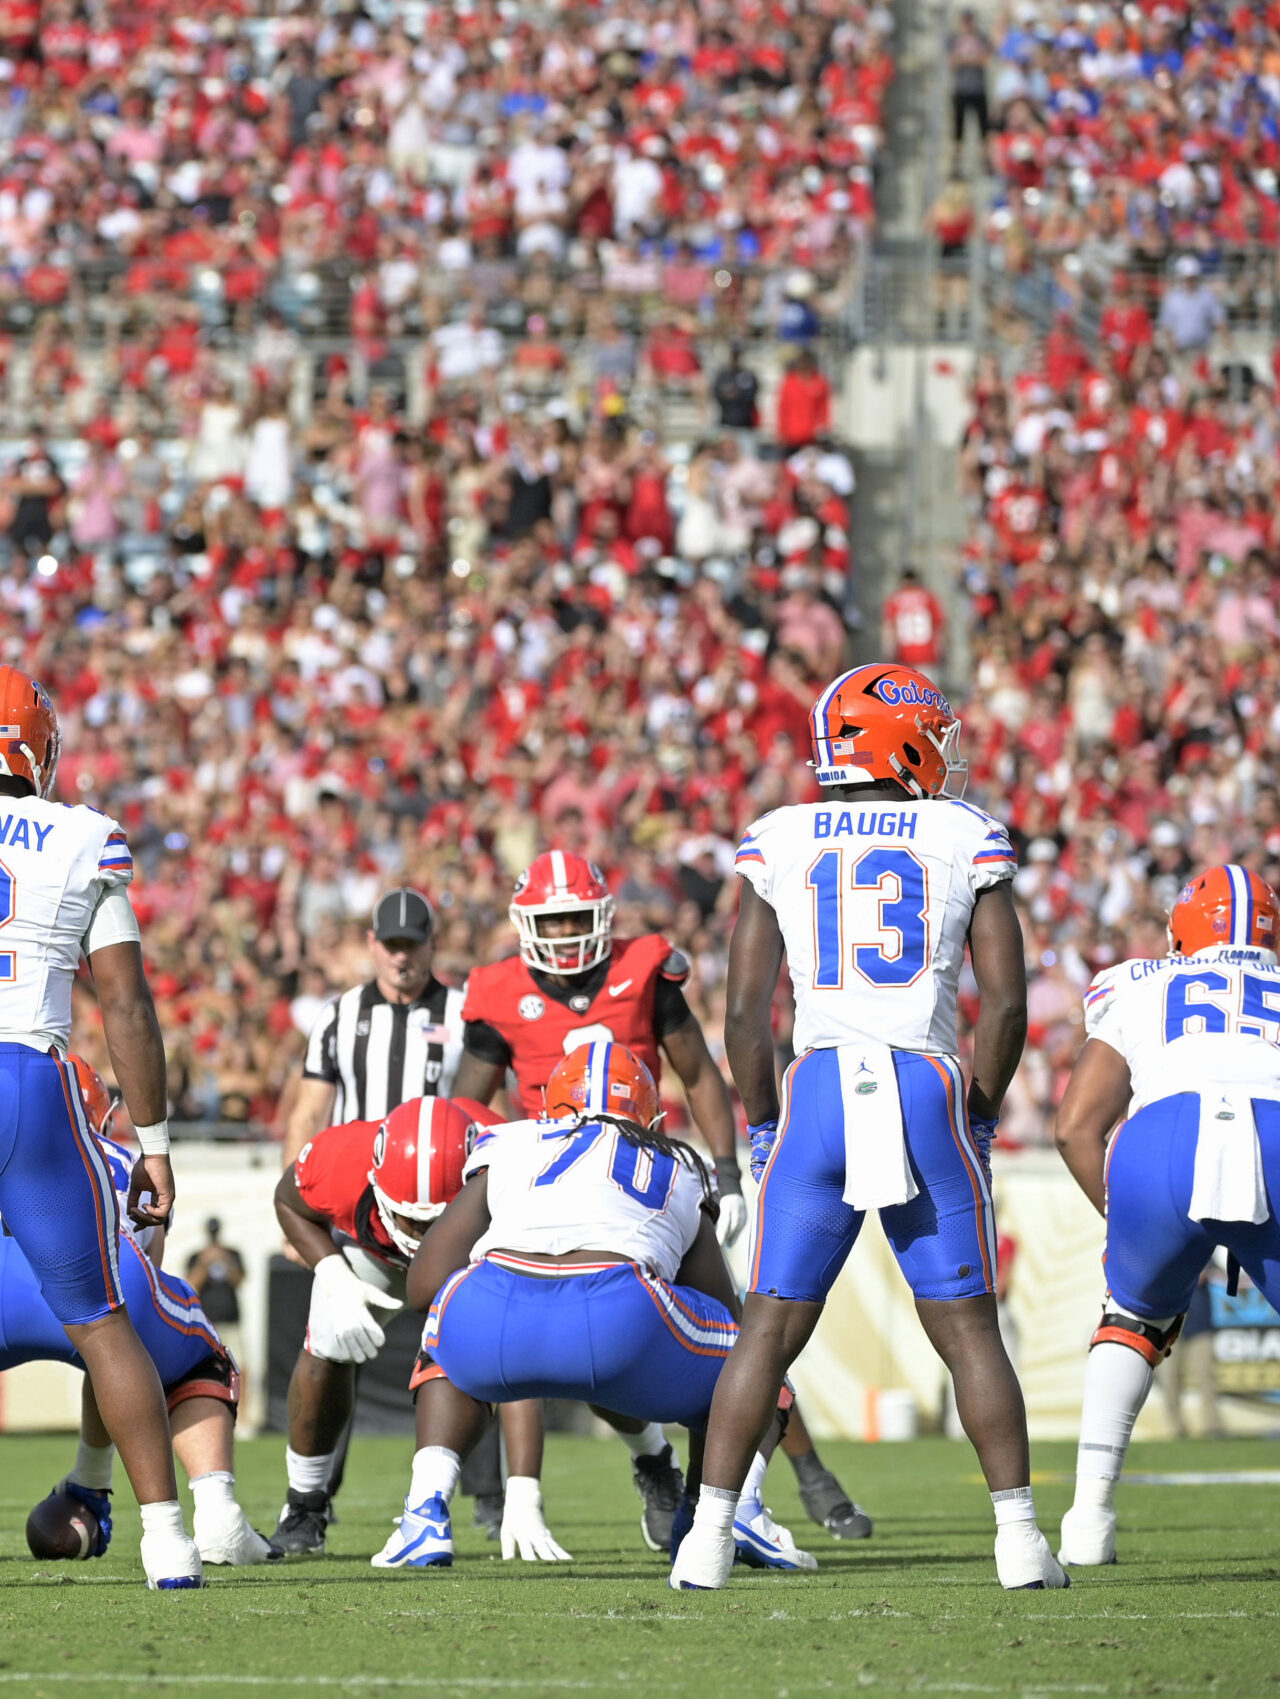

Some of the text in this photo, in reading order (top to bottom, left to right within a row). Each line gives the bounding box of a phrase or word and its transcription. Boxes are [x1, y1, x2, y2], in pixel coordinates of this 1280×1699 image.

[877, 679, 952, 716] Gators
[814, 811, 918, 839] BAUGH
[805, 845, 929, 990] 13
[1219, 950, 1261, 961] FLORIDA
[1162, 968, 1280, 1049] 65
[529, 1124, 680, 1215] 70
